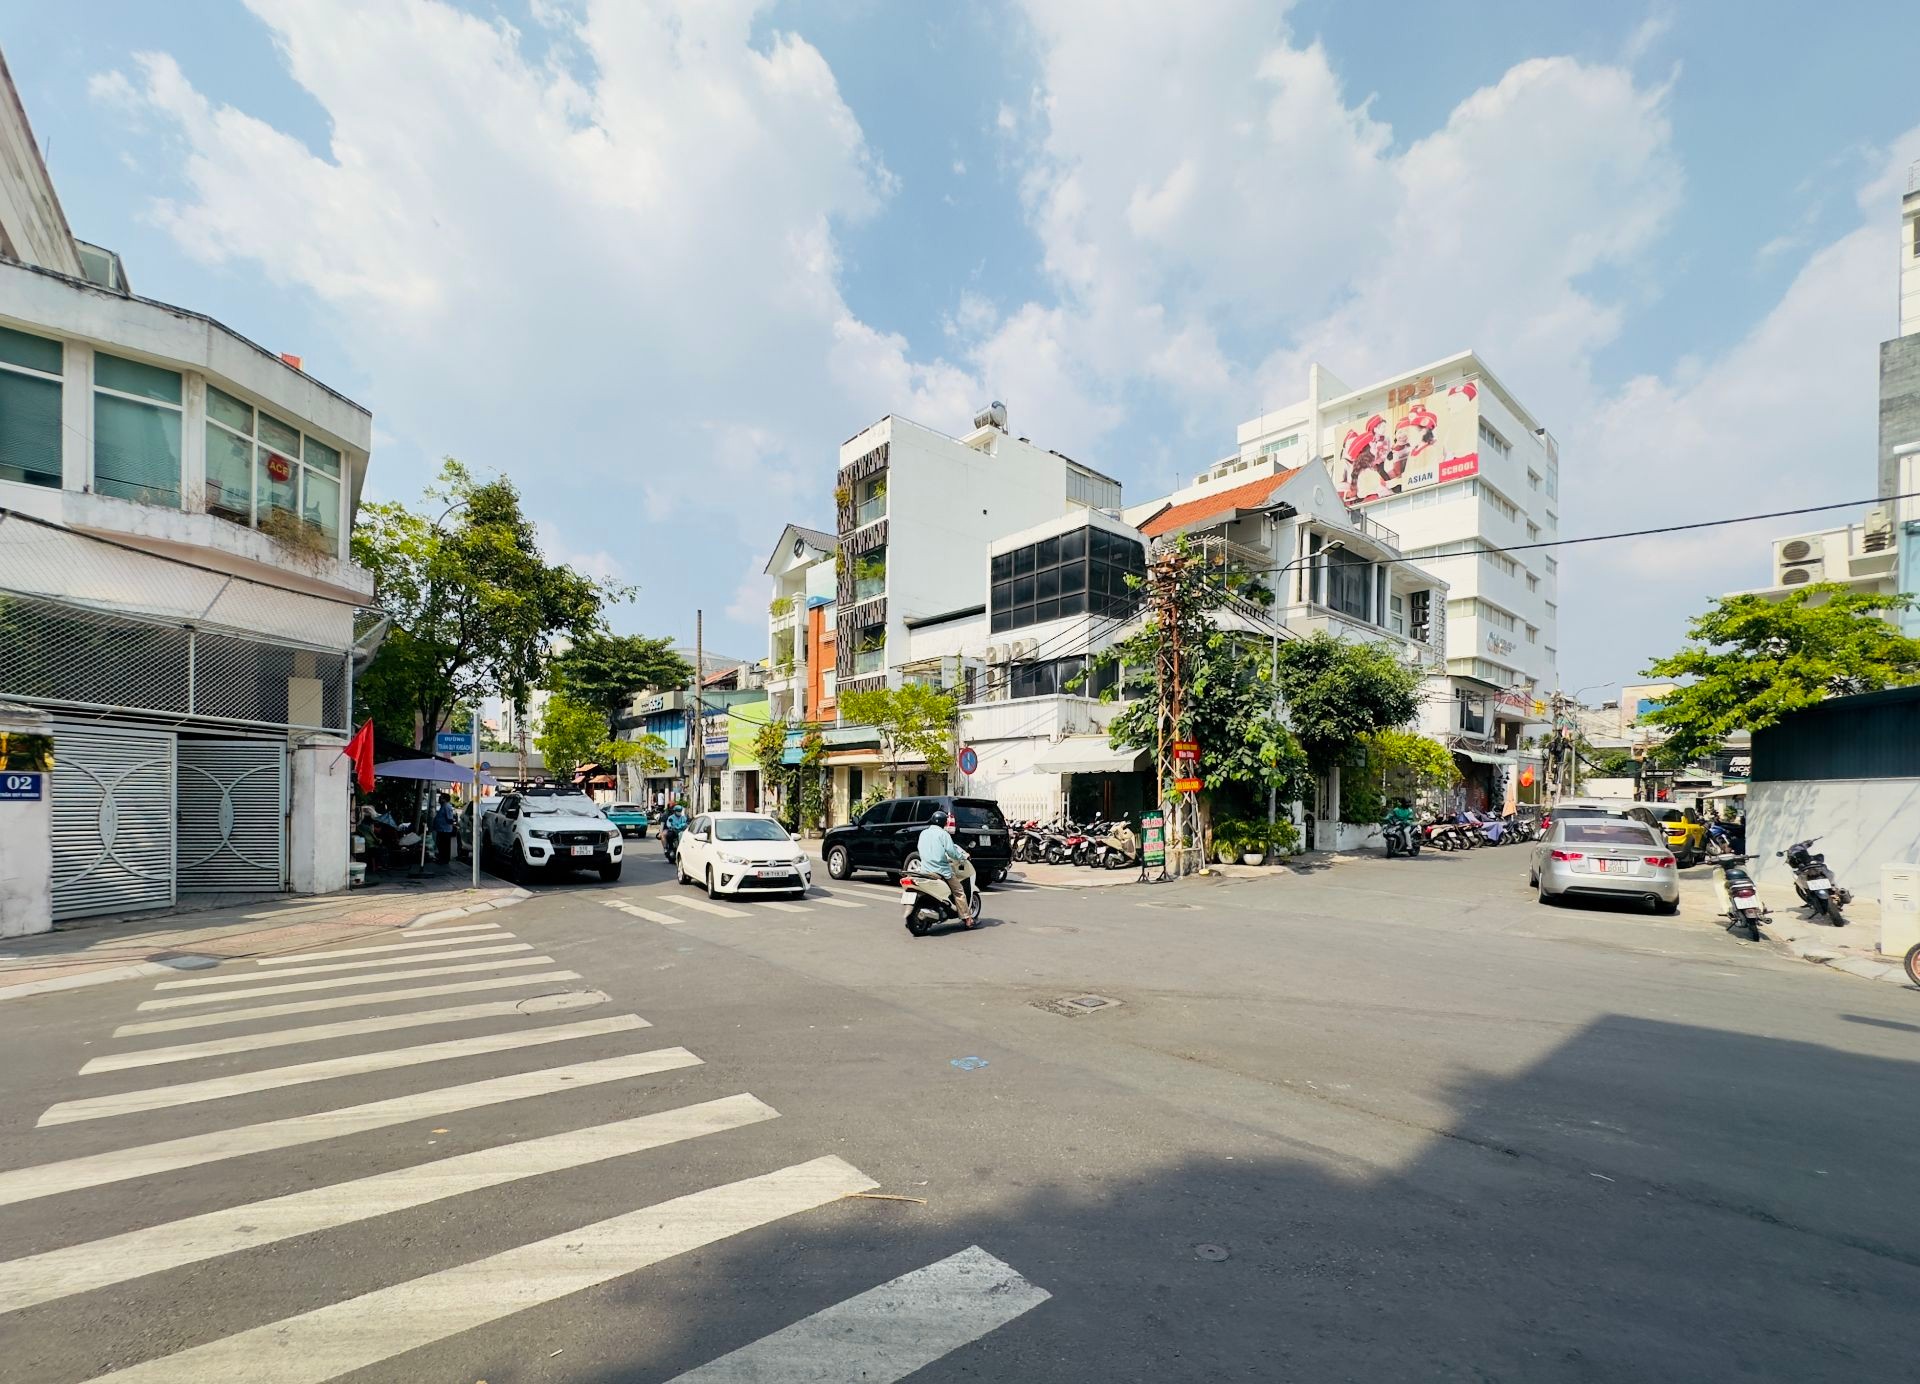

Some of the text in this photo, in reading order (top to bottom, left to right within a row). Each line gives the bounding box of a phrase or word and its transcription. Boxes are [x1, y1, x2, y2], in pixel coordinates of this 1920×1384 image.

[1408, 461, 1474, 485] ASIAN SCHOOL
[7, 776, 32, 790] 02
